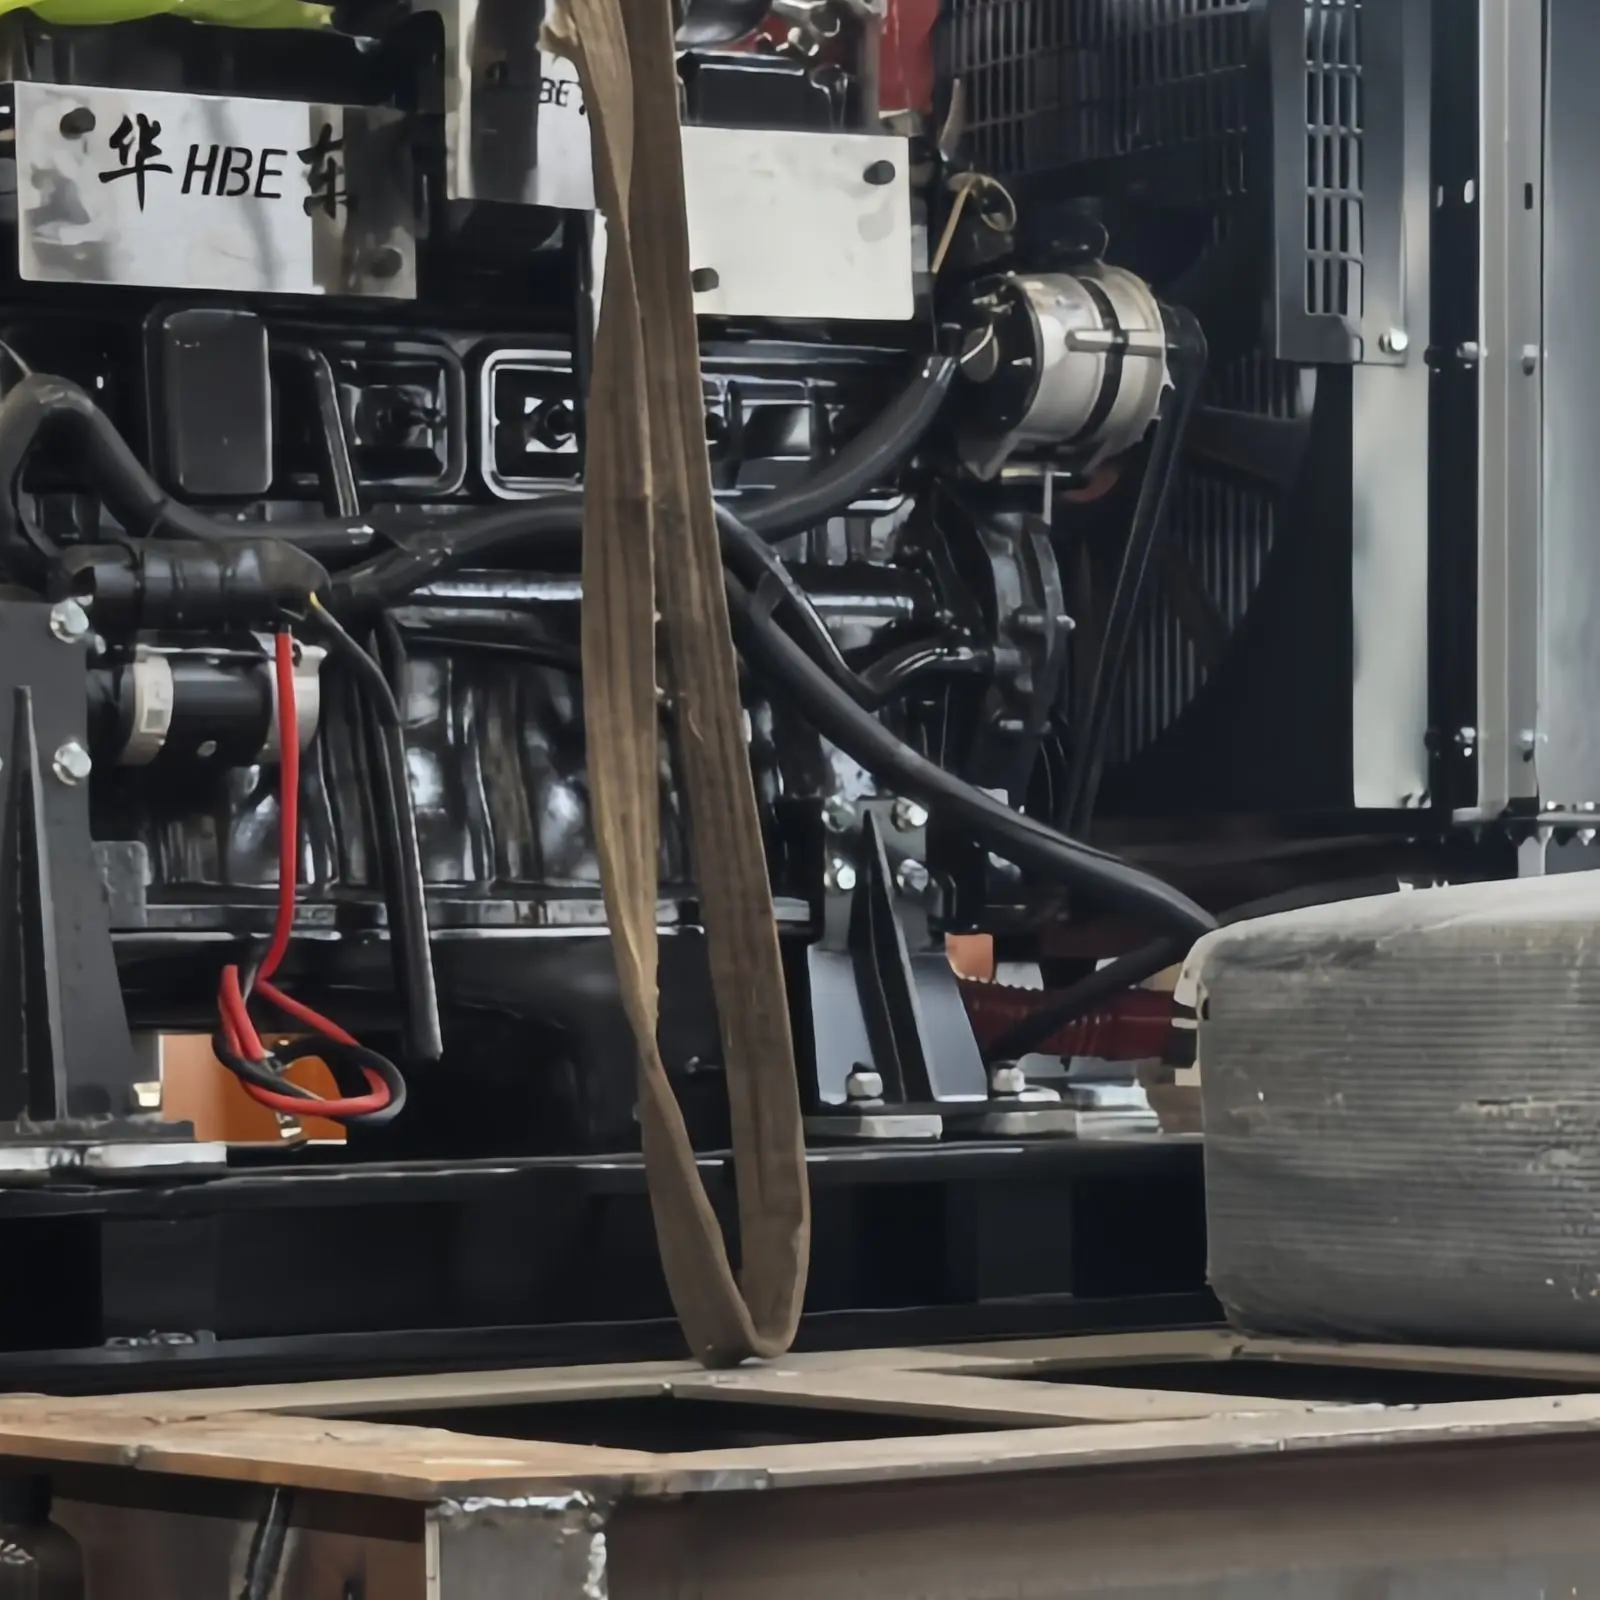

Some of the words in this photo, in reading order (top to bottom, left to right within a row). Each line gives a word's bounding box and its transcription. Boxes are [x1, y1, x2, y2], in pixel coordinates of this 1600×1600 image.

[538, 76, 570, 108] BE
[98, 111, 173, 212] 华
[180, 143, 288, 199] HBE
